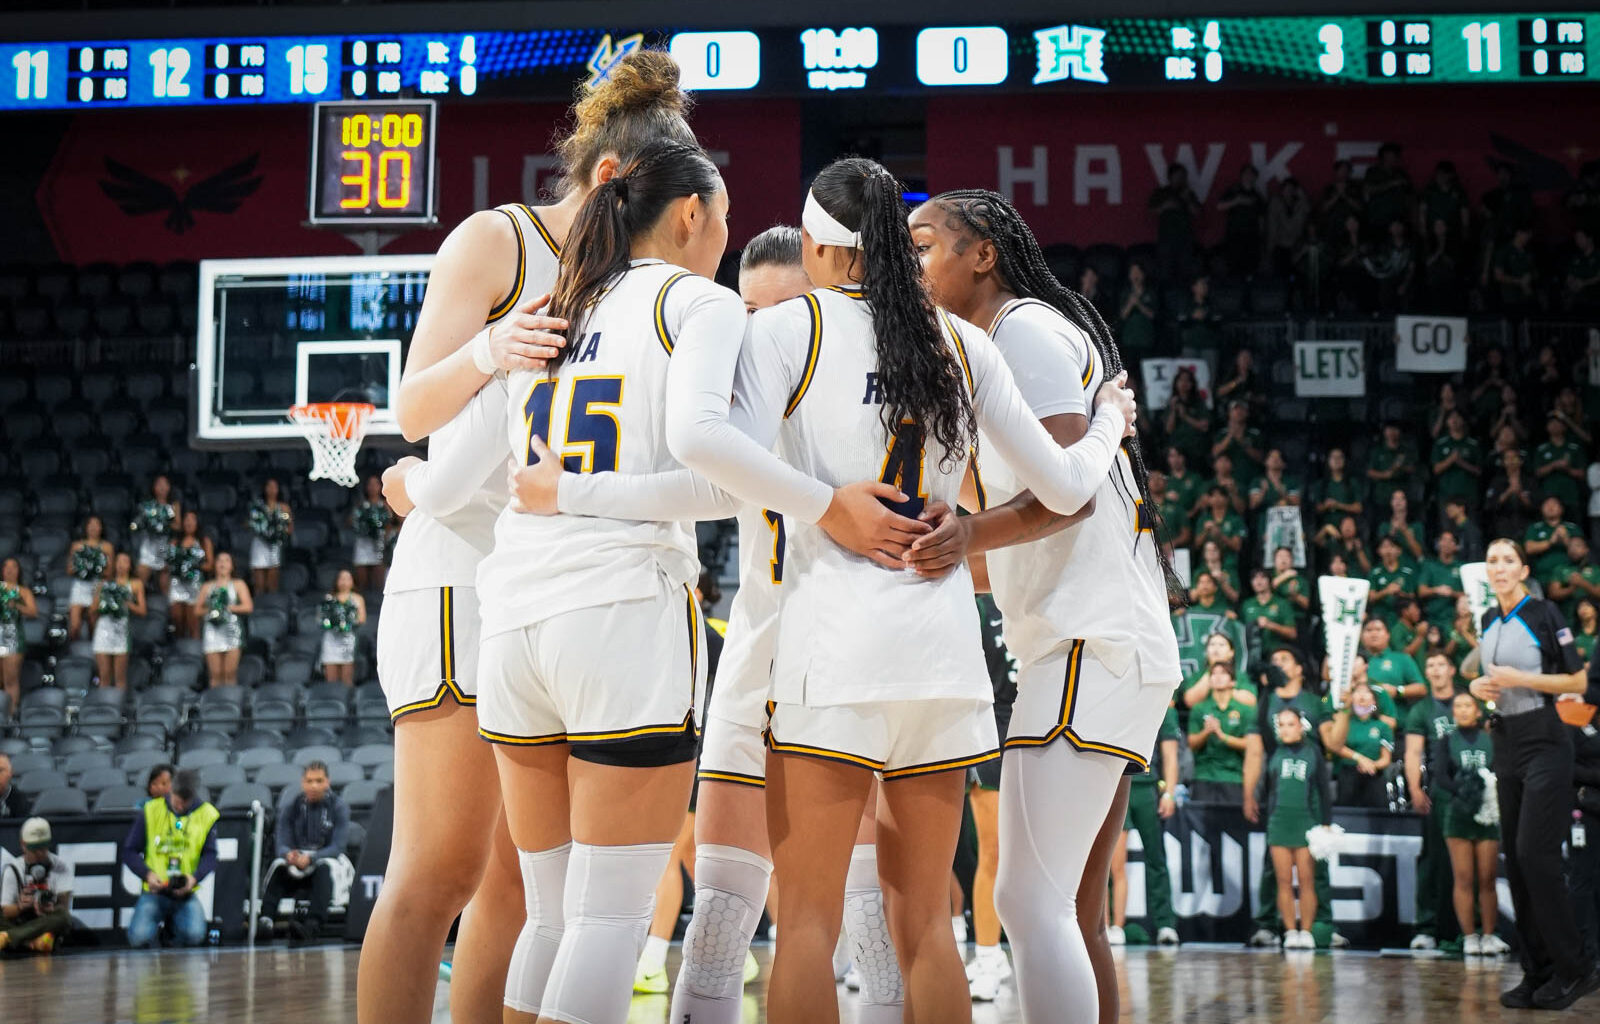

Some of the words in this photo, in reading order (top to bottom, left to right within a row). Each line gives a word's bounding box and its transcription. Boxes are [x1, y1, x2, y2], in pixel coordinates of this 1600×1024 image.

[1204, 21, 1221, 50] 4
[1381, 21, 1396, 45] 0
[1533, 18, 1547, 43] 0
[81, 47, 94, 72] 0
[215, 44, 229, 68] 0
[353, 41, 367, 65] 0
[460, 35, 476, 64] 4
[706, 41, 721, 78] 0
[954, 36, 968, 73] 0
[1318, 24, 1344, 74] 3
[1462, 22, 1501, 72] 11
[1534, 49, 1548, 74] 0
[13, 50, 49, 99] 11
[149, 48, 191, 97] 12
[286, 44, 328, 94] 15
[1205, 51, 1222, 81] 0
[1382, 51, 1396, 76] 0
[80, 77, 94, 102] 0
[215, 74, 229, 98] 0
[352, 71, 367, 96] 0
[460, 66, 477, 95] 0
[342, 113, 423, 148] 10:00
[340, 151, 411, 209] 30
[1412, 322, 1452, 354] GO
[1300, 347, 1359, 380] LETS
[522, 374, 626, 475] 15
[878, 418, 929, 520] 4
[1280, 758, 1308, 781] H
